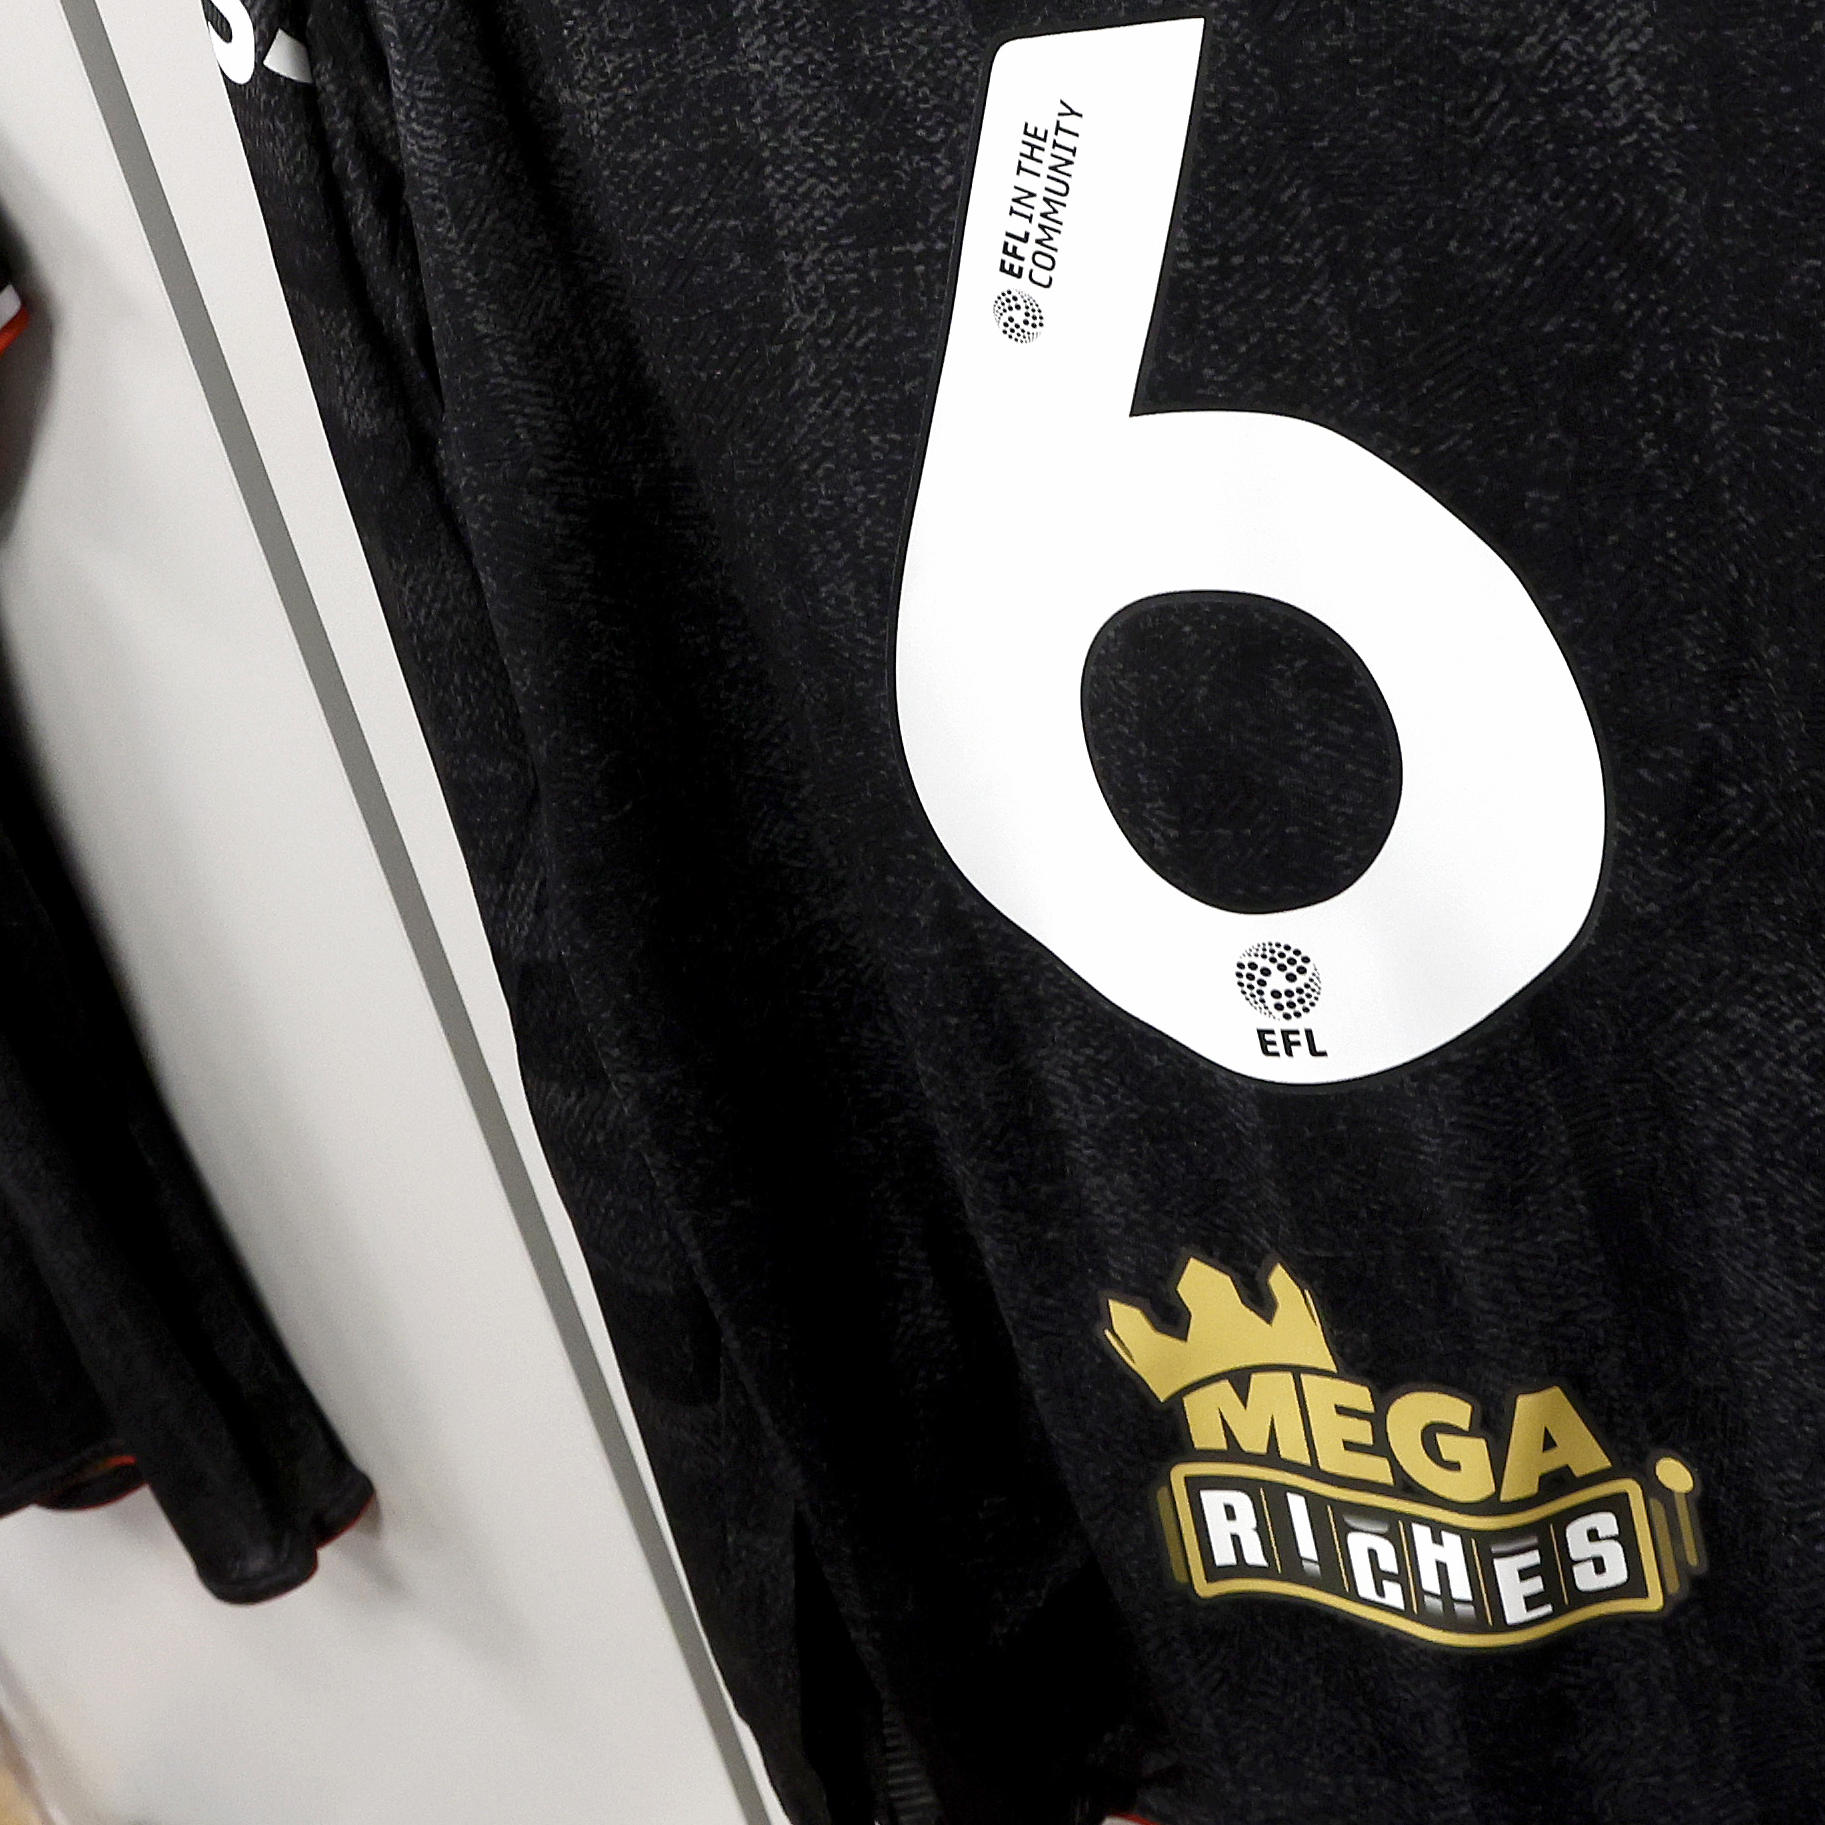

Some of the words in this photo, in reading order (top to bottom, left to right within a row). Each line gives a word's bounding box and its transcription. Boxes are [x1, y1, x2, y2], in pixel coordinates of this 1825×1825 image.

[1016, 121, 1048, 178] THE
[1028, 99, 1083, 289] COMMUNITY
[1009, 185, 1037, 224] IN
[999, 231, 1030, 279] EFL
[894, 17, 1607, 1085] 6
[1256, 1027, 1328, 1058] EFL
[1182, 1370, 1612, 1504] MEGA
[1199, 1489, 1628, 1626] RICHES
